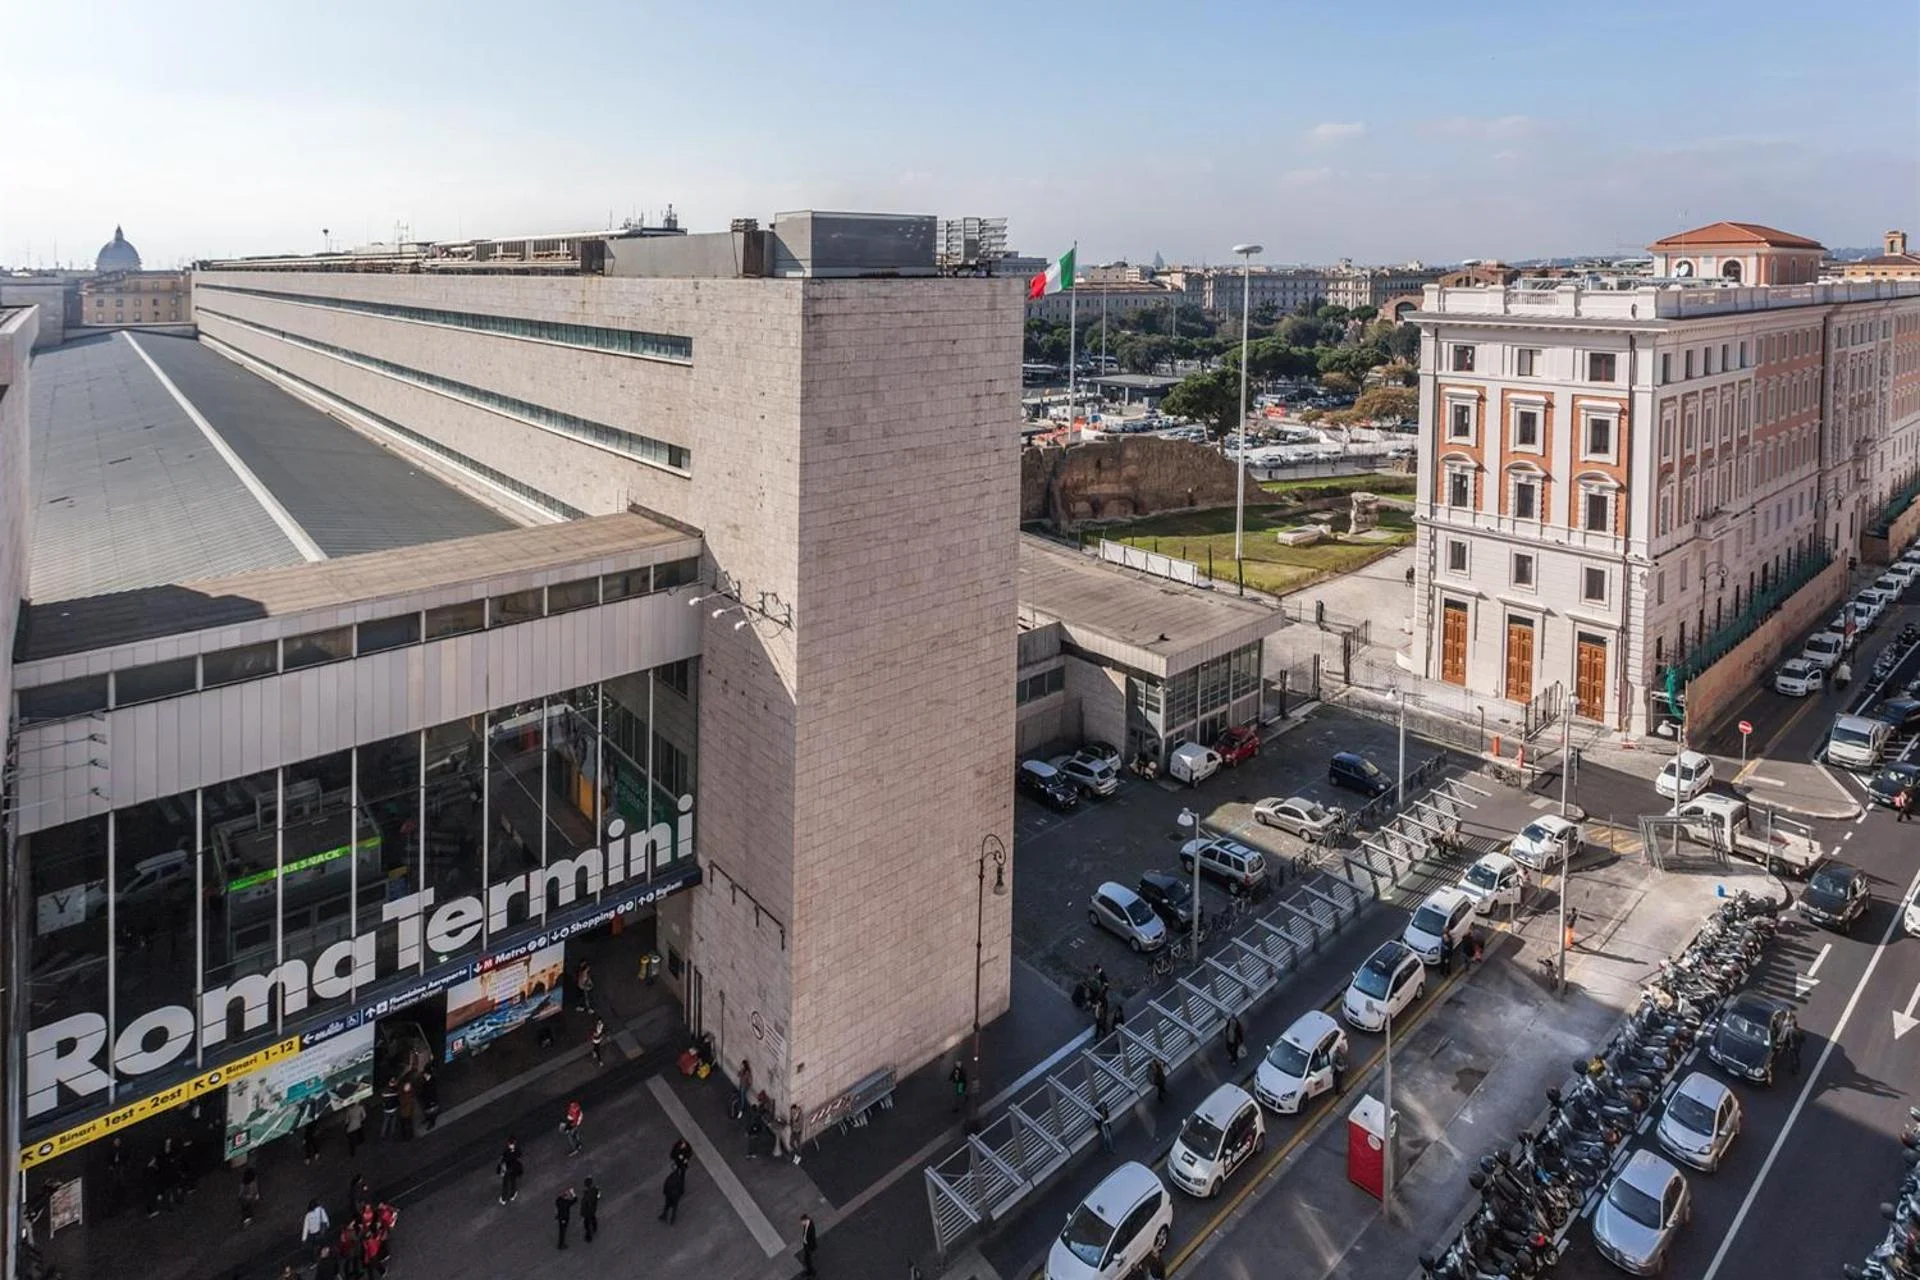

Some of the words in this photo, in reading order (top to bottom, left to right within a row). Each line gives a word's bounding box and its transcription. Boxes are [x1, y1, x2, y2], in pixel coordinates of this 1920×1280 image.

[300, 849, 341, 868] SNACK
[570, 911, 615, 933] Shopping
[495, 946, 526, 964] Metro
[225, 1055, 258, 1075] Binari
[59, 1123, 96, 1145] Binari
[104, 1108, 134, 1127] 1est
[150, 1089, 182, 1108] 2est
